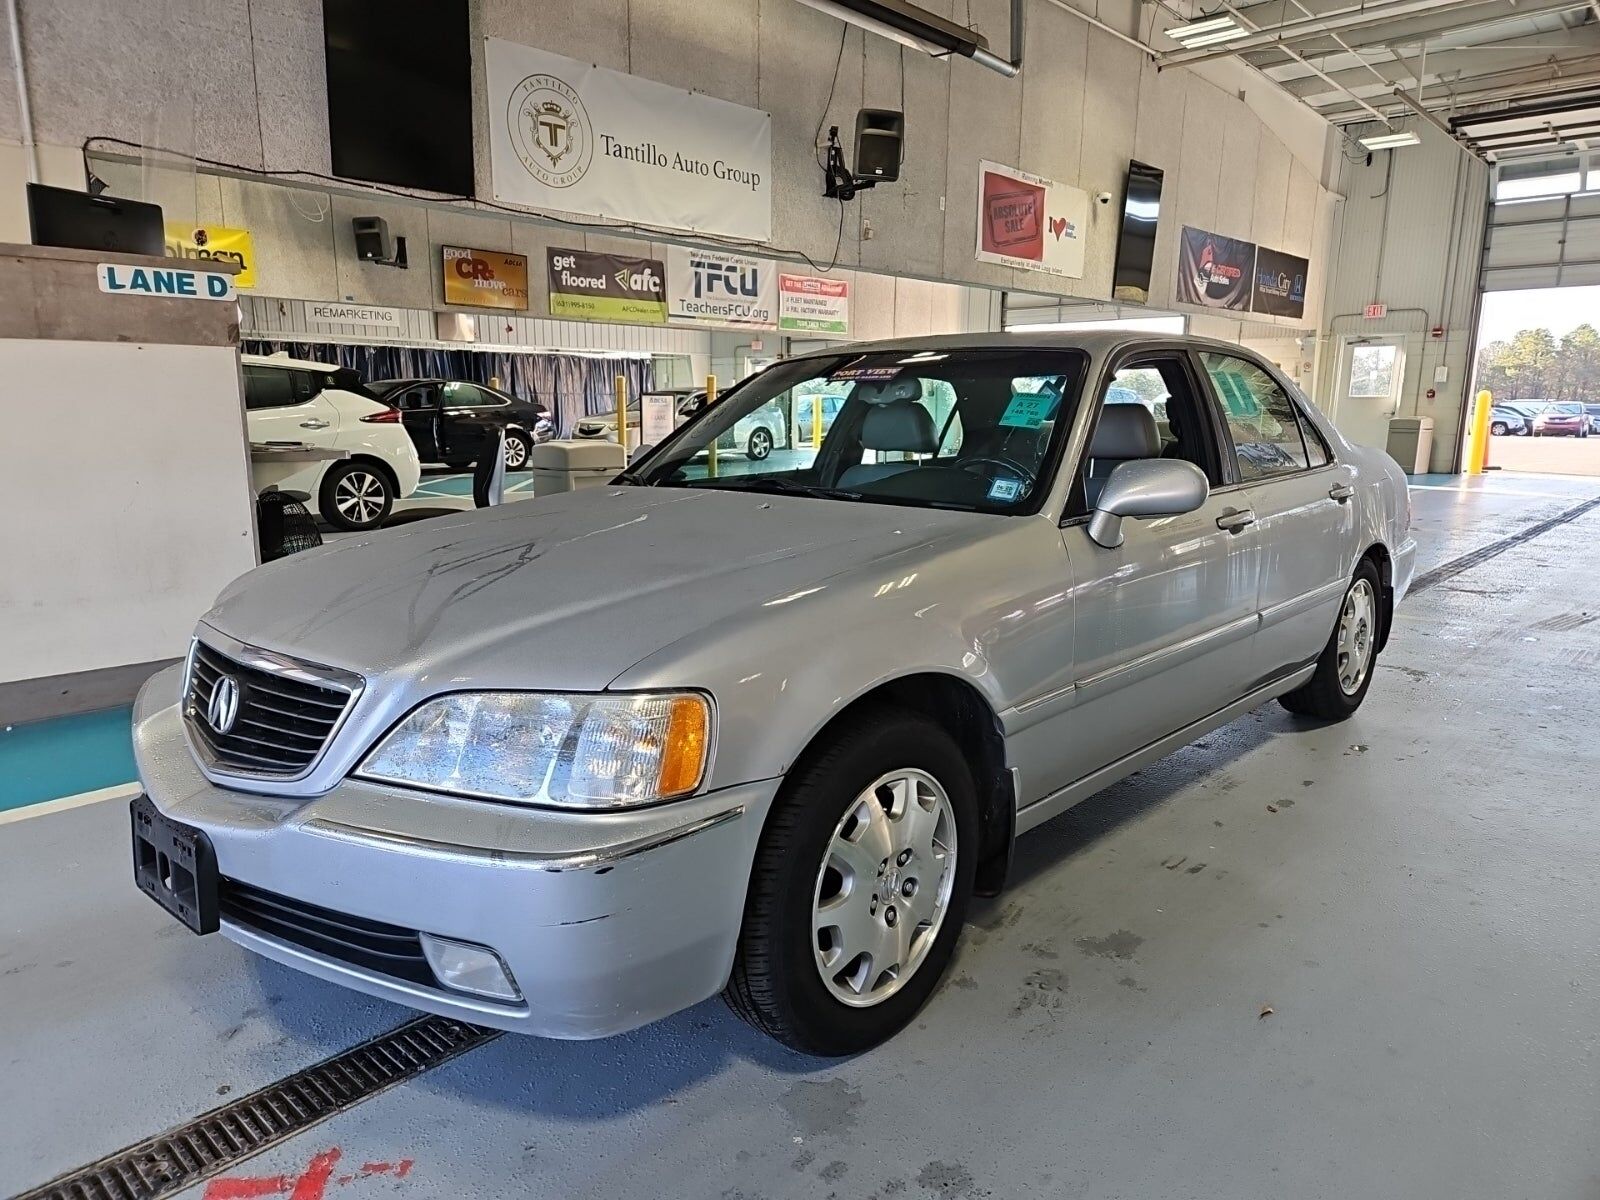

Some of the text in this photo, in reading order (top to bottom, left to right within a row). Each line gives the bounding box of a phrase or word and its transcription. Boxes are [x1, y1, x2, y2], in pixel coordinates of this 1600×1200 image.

[523, 78, 578, 104] TANTILLO
[523, 156, 583, 184] AUTO GROUP
[600, 134, 760, 191] Tantillo Auto Group
[993, 202, 1032, 220] ABSOLUTE
[1004, 218, 1024, 233] SALE
[444, 249, 472, 260] good
[553, 255, 576, 271] get
[106, 266, 228, 298] LANE D
[474, 278, 506, 290] move
[561, 270, 606, 289] floored
[630, 268, 661, 292] afc
[690, 260, 758, 298] TFCU
[502, 287, 528, 298] cars
[314, 307, 392, 322] REMARKETING
[679, 299, 769, 321] TeachersFCU.org
[1366, 305, 1383, 317] EXIT
[832, 369, 865, 377] PORT
